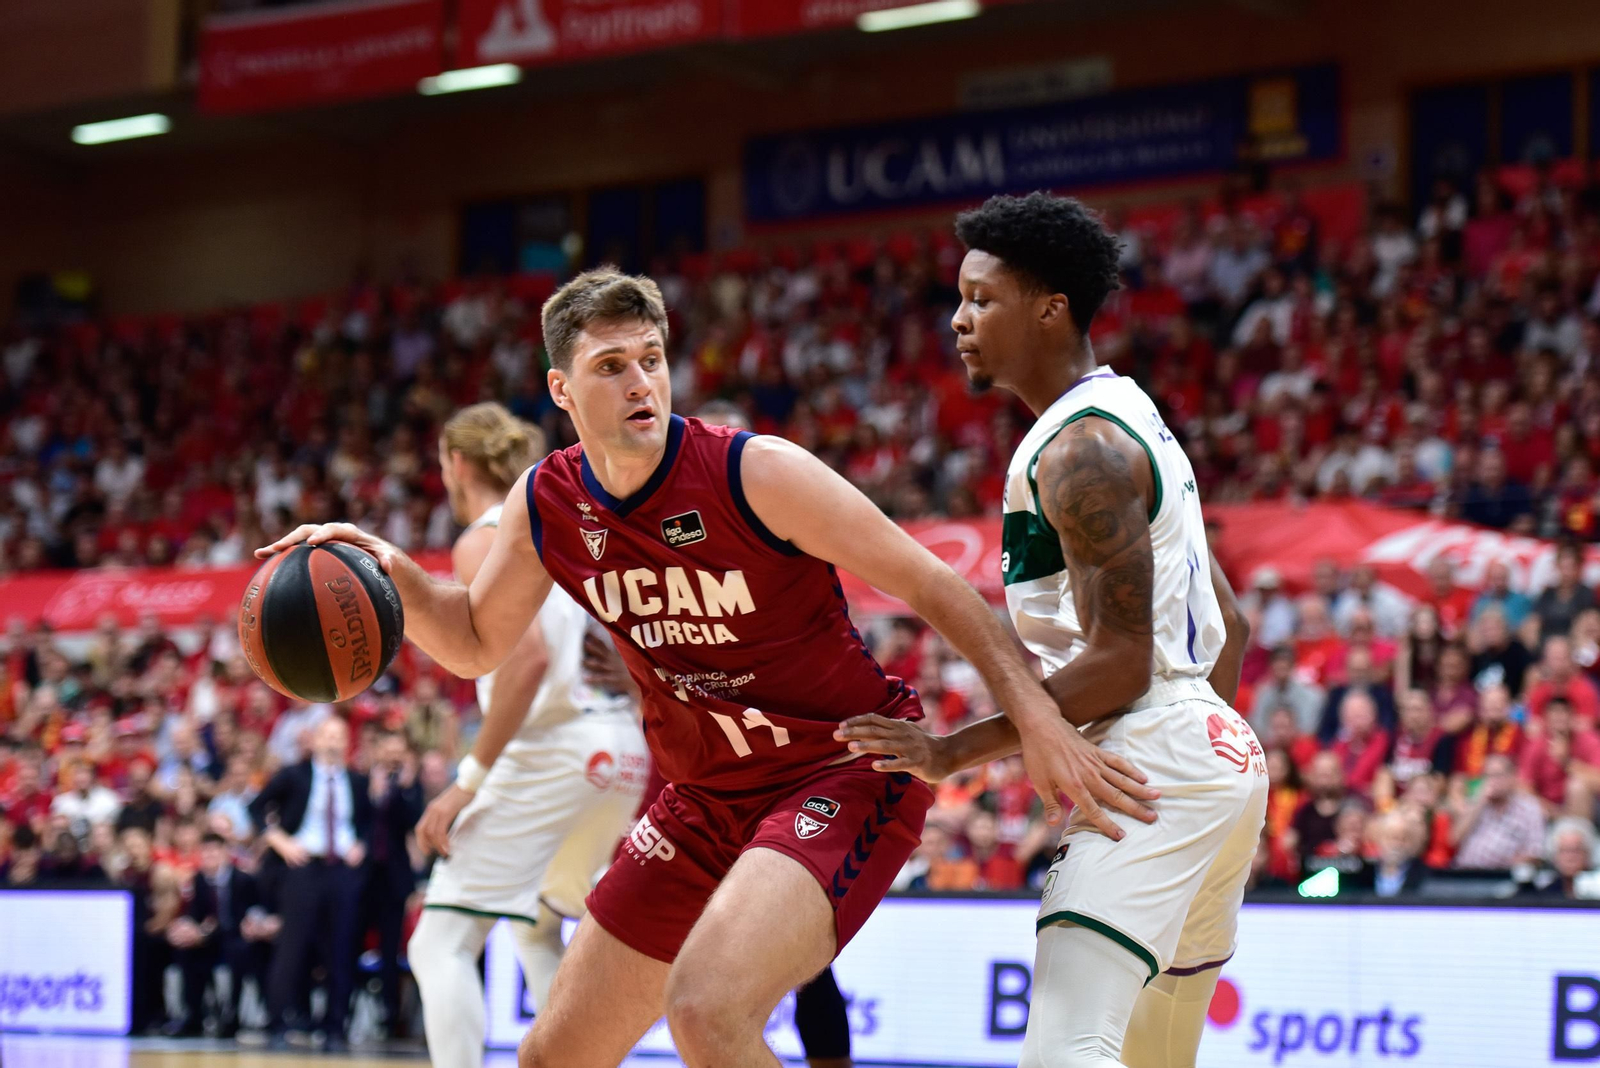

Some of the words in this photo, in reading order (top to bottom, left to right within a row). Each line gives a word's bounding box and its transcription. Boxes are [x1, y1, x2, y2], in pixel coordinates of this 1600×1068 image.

[826, 133, 1004, 200] UCAM
[665, 527, 682, 537] liga
[669, 529, 703, 544] endesa
[582, 566, 757, 623] UCAM
[324, 574, 373, 683] SPALDING
[729, 672, 756, 688] 2024
[806, 801, 829, 812] acb
[1249, 1007, 1423, 1065] sports
